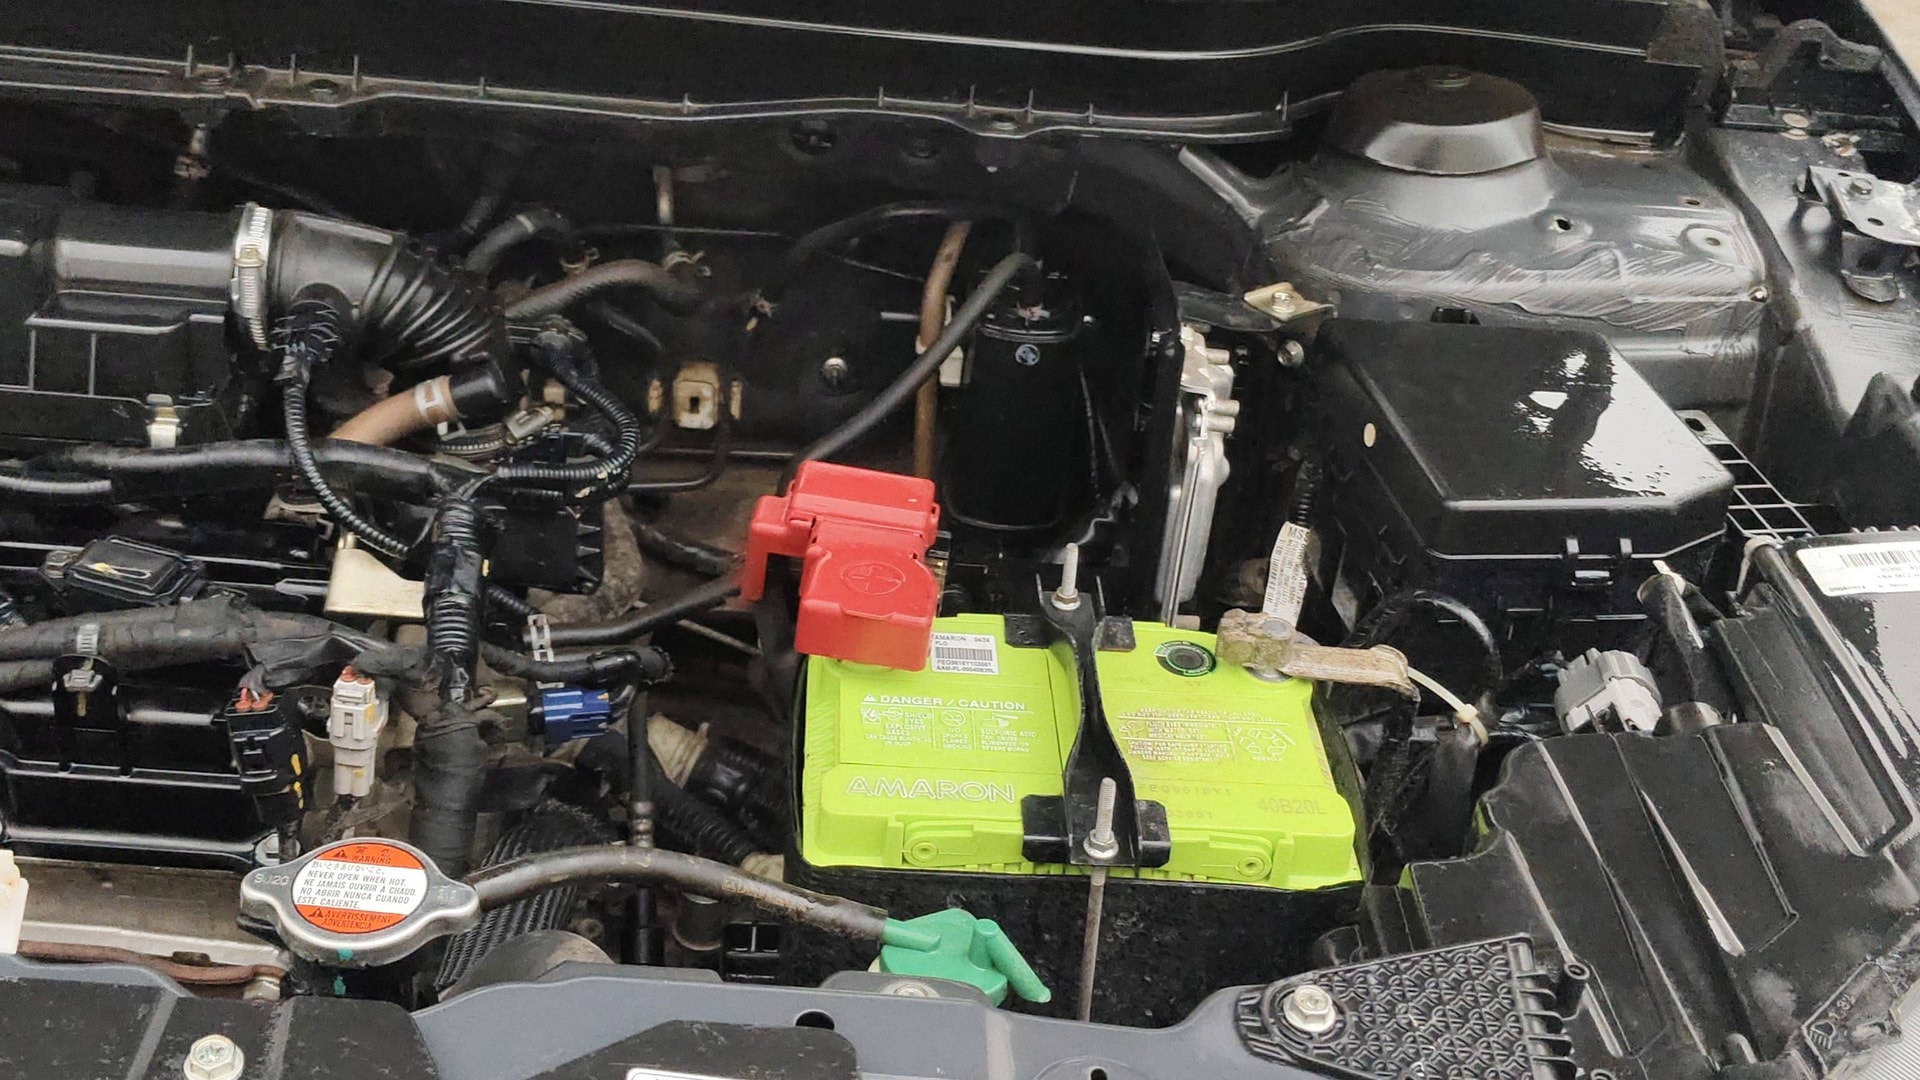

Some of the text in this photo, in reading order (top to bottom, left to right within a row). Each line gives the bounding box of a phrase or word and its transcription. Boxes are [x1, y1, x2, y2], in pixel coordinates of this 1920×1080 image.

[880, 695, 943, 706] DANGER
[958, 699, 1025, 710] CAUTION
[847, 776, 1015, 803] AMARON
[1258, 798, 1327, 815] 40B20L
[352, 855, 392, 865] WARNING
[307, 870, 406, 887] NEVER OPEN WHEN HOT.
[300, 887, 410, 904] NO ABRIR NUNCA CUANDO
[303, 879, 313, 887] NE
[315, 880, 346, 891] JAMAIS
[348, 883, 377, 893] OUVRIR
[387, 886, 416, 897] CHAUD.
[297, 895, 361, 909] ESTE CALIENTE.
[321, 917, 372, 930] ADVERTENCIA
[324, 910, 393, 924] AVERTISSEMENT
